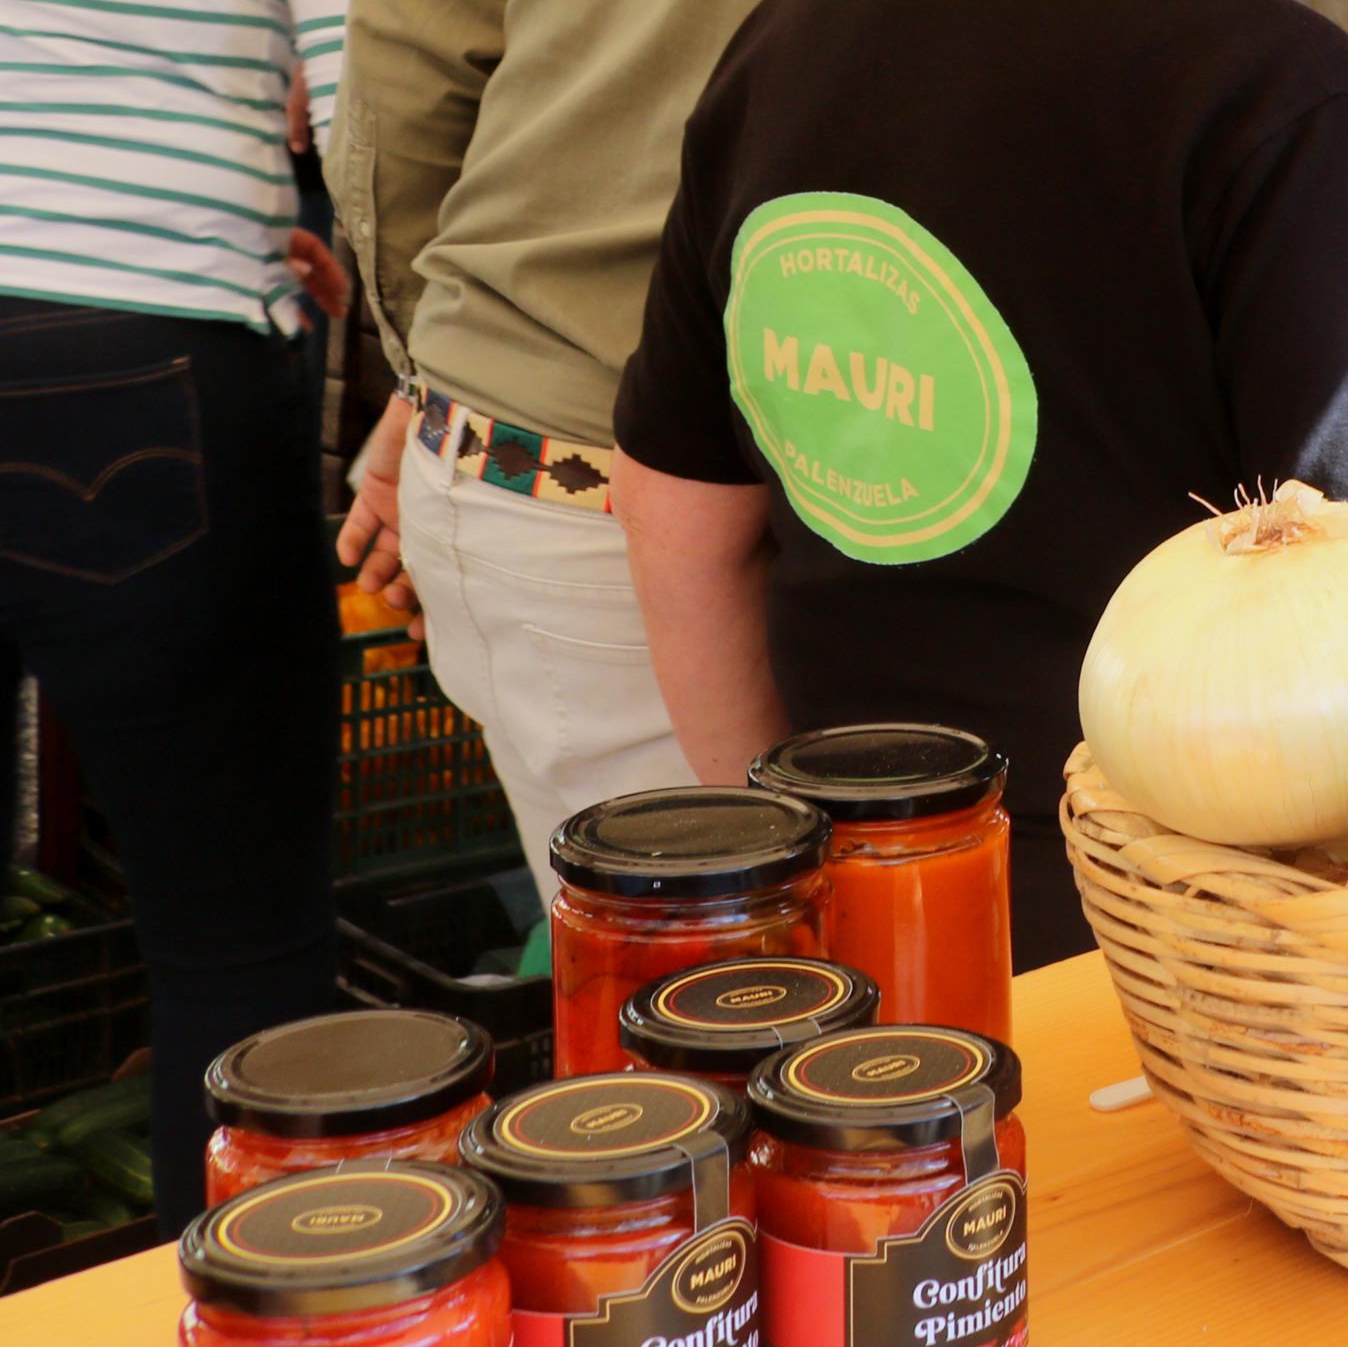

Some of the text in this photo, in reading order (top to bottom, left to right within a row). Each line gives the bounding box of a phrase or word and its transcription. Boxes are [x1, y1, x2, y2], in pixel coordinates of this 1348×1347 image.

[779, 248, 921, 315] HORTALIZAS
[763, 326, 936, 431] MAURI
[782, 440, 920, 507] PALENZUELA
[963, 1205, 1007, 1237] MAURI
[690, 1253, 737, 1291] MAURI
[914, 1279, 1026, 1347] Pimiento
